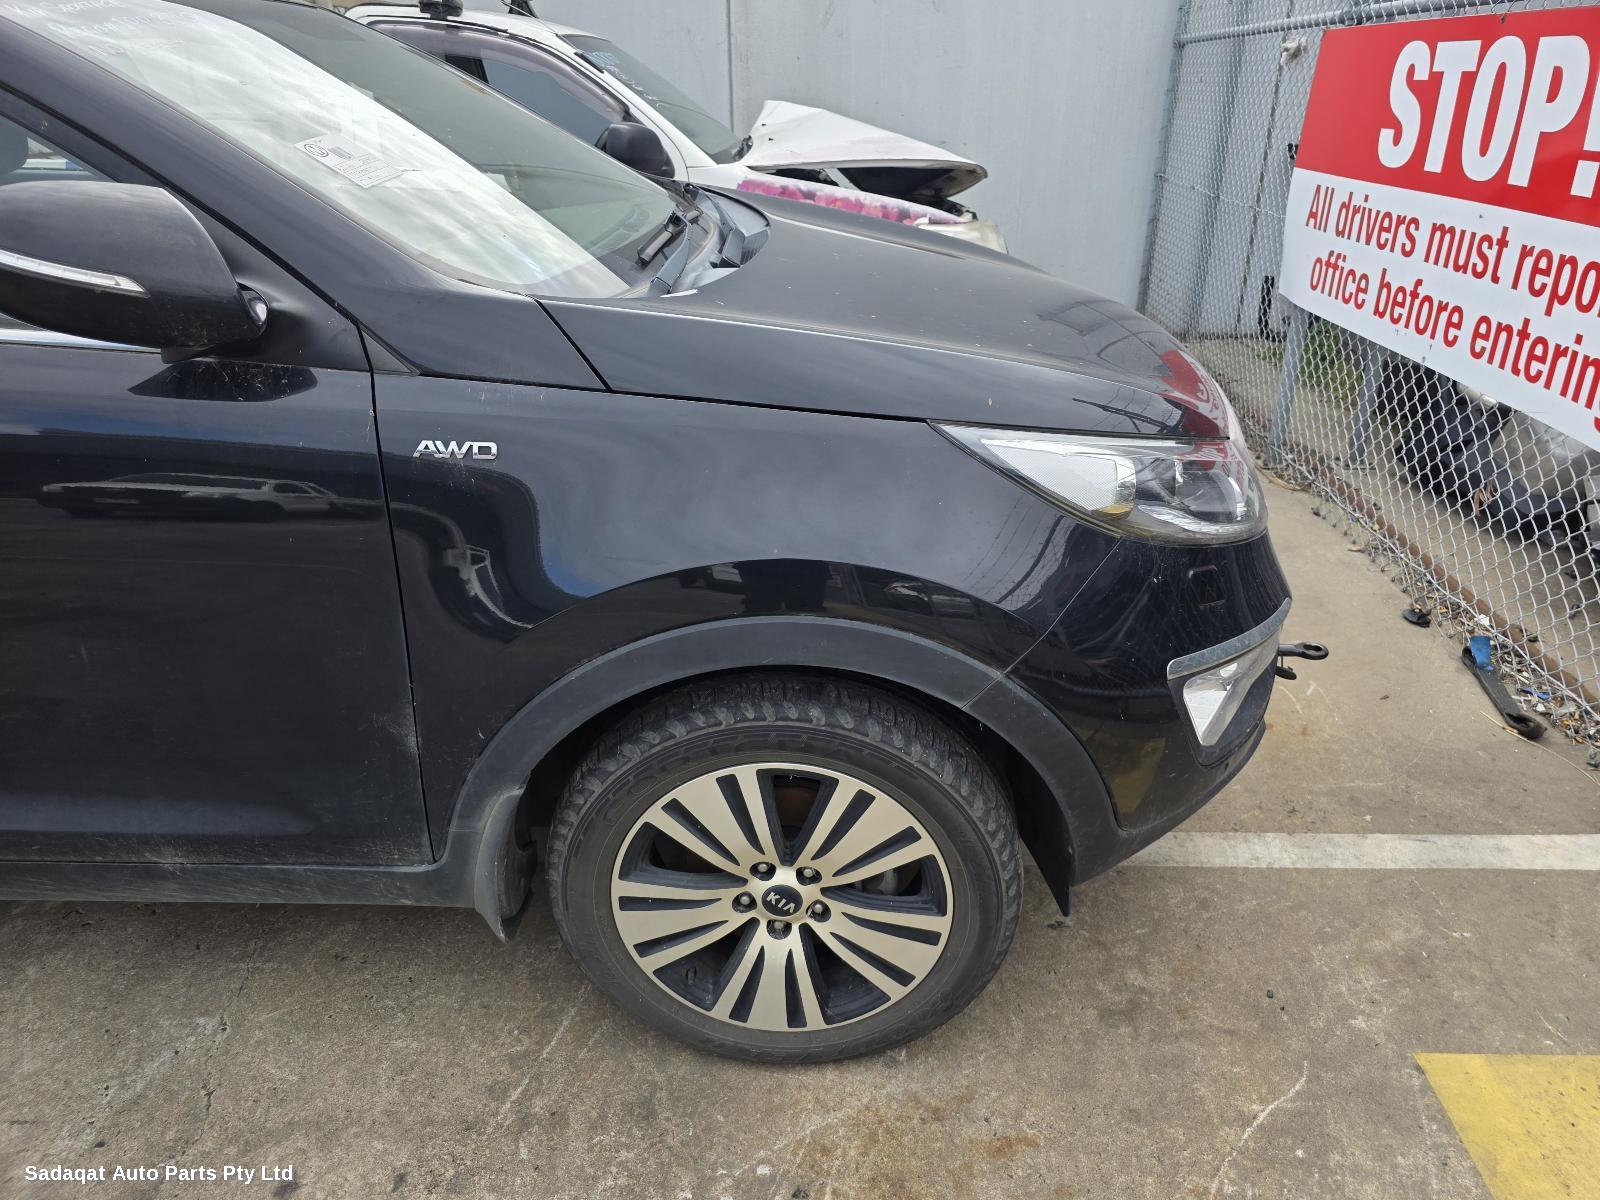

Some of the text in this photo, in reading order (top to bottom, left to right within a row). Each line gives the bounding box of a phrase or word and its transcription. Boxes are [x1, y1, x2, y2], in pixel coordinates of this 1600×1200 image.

[1305, 184, 1600, 318] All drivers must repo
[1309, 249, 1370, 310] office
[1372, 267, 1464, 348] before
[412, 439, 498, 460] AWD
[766, 891, 796, 914] KIA
